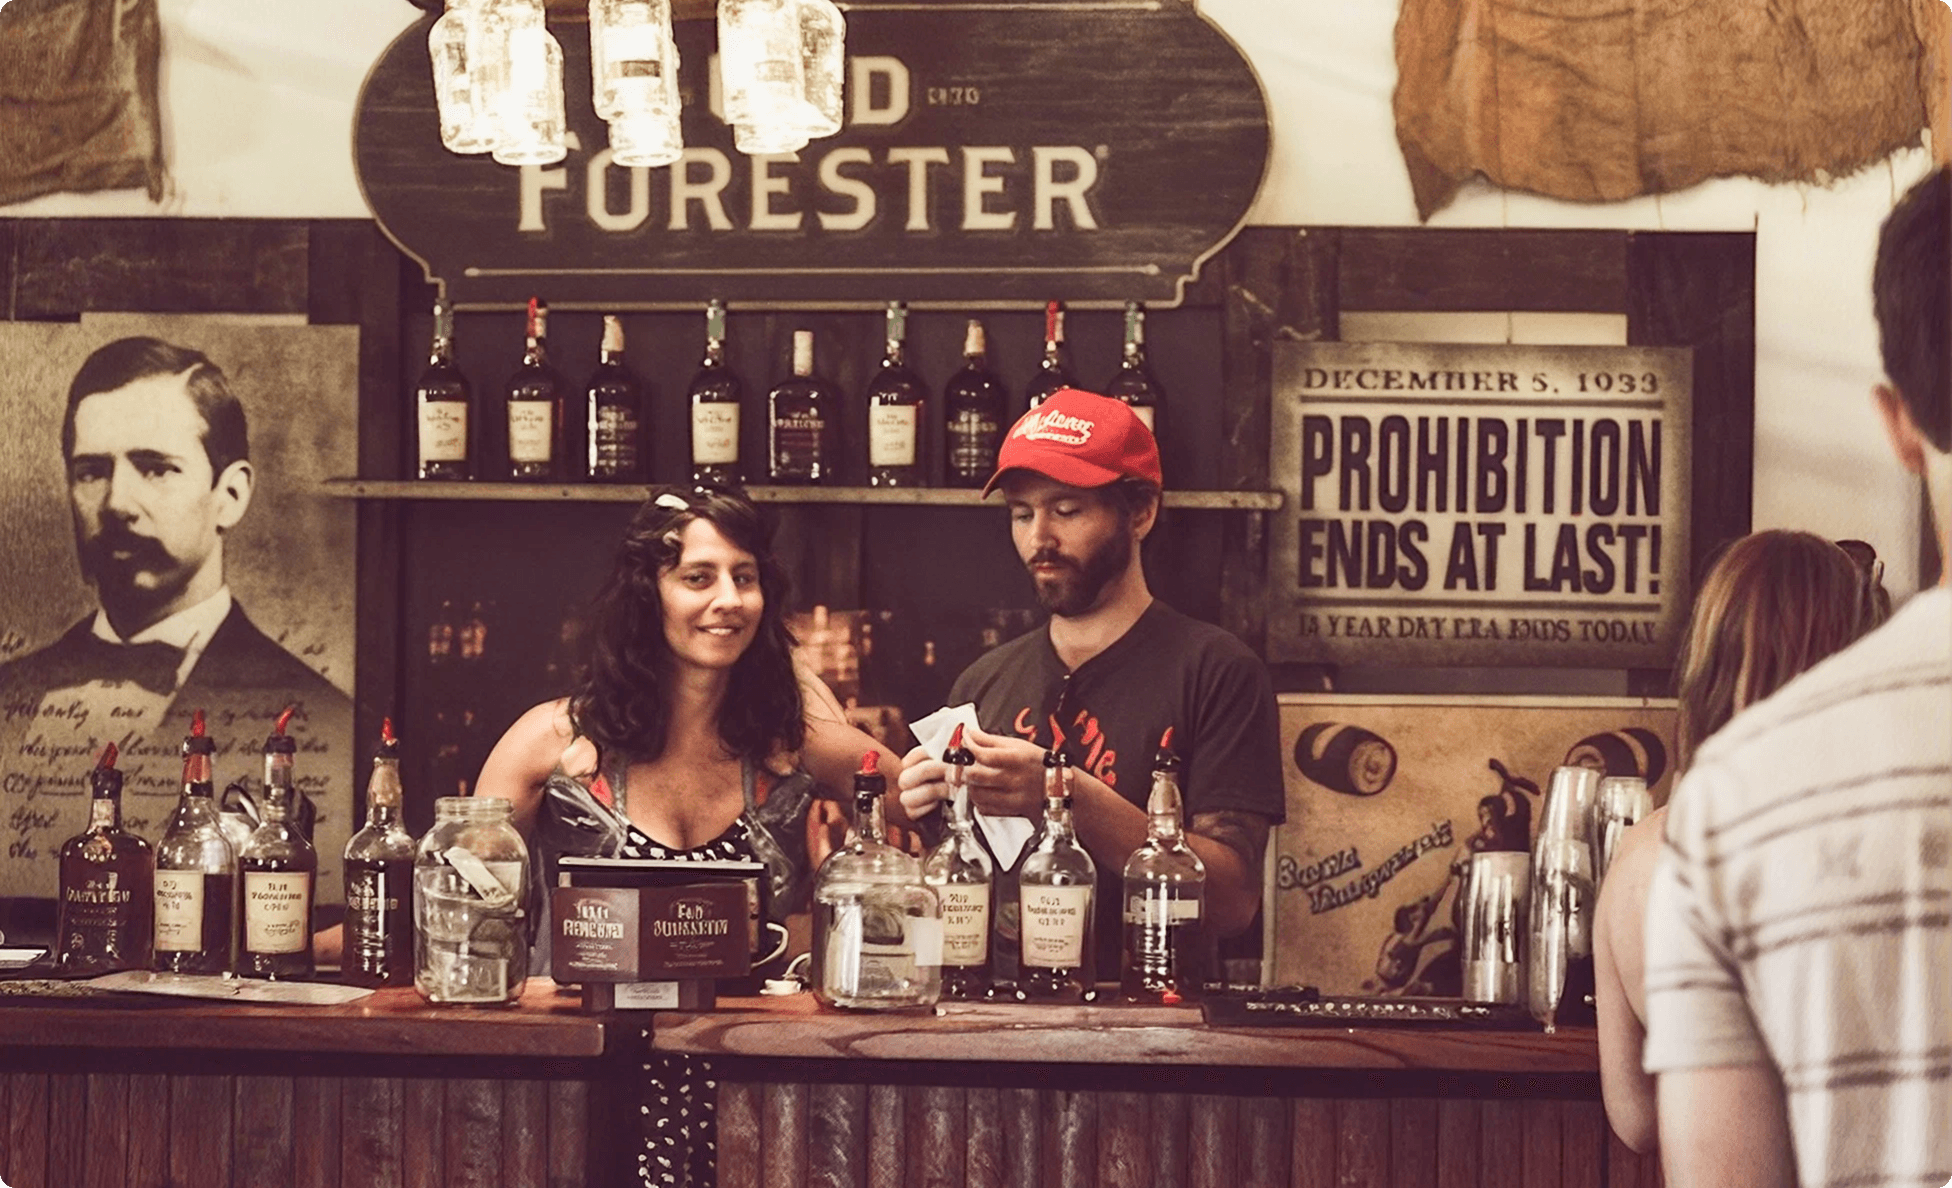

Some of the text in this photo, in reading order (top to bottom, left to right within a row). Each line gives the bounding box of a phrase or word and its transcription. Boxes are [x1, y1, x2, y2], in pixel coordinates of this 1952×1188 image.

[518, 131, 1100, 232] FORESTER
[1303, 368, 1518, 392] DECEMBER
[1301, 414, 1662, 517] PROHIBITION
[1298, 518, 1661, 595] ENDS AT LAST!
[1327, 614, 1392, 638] YEAR
[1578, 619, 1656, 646] TODAY
